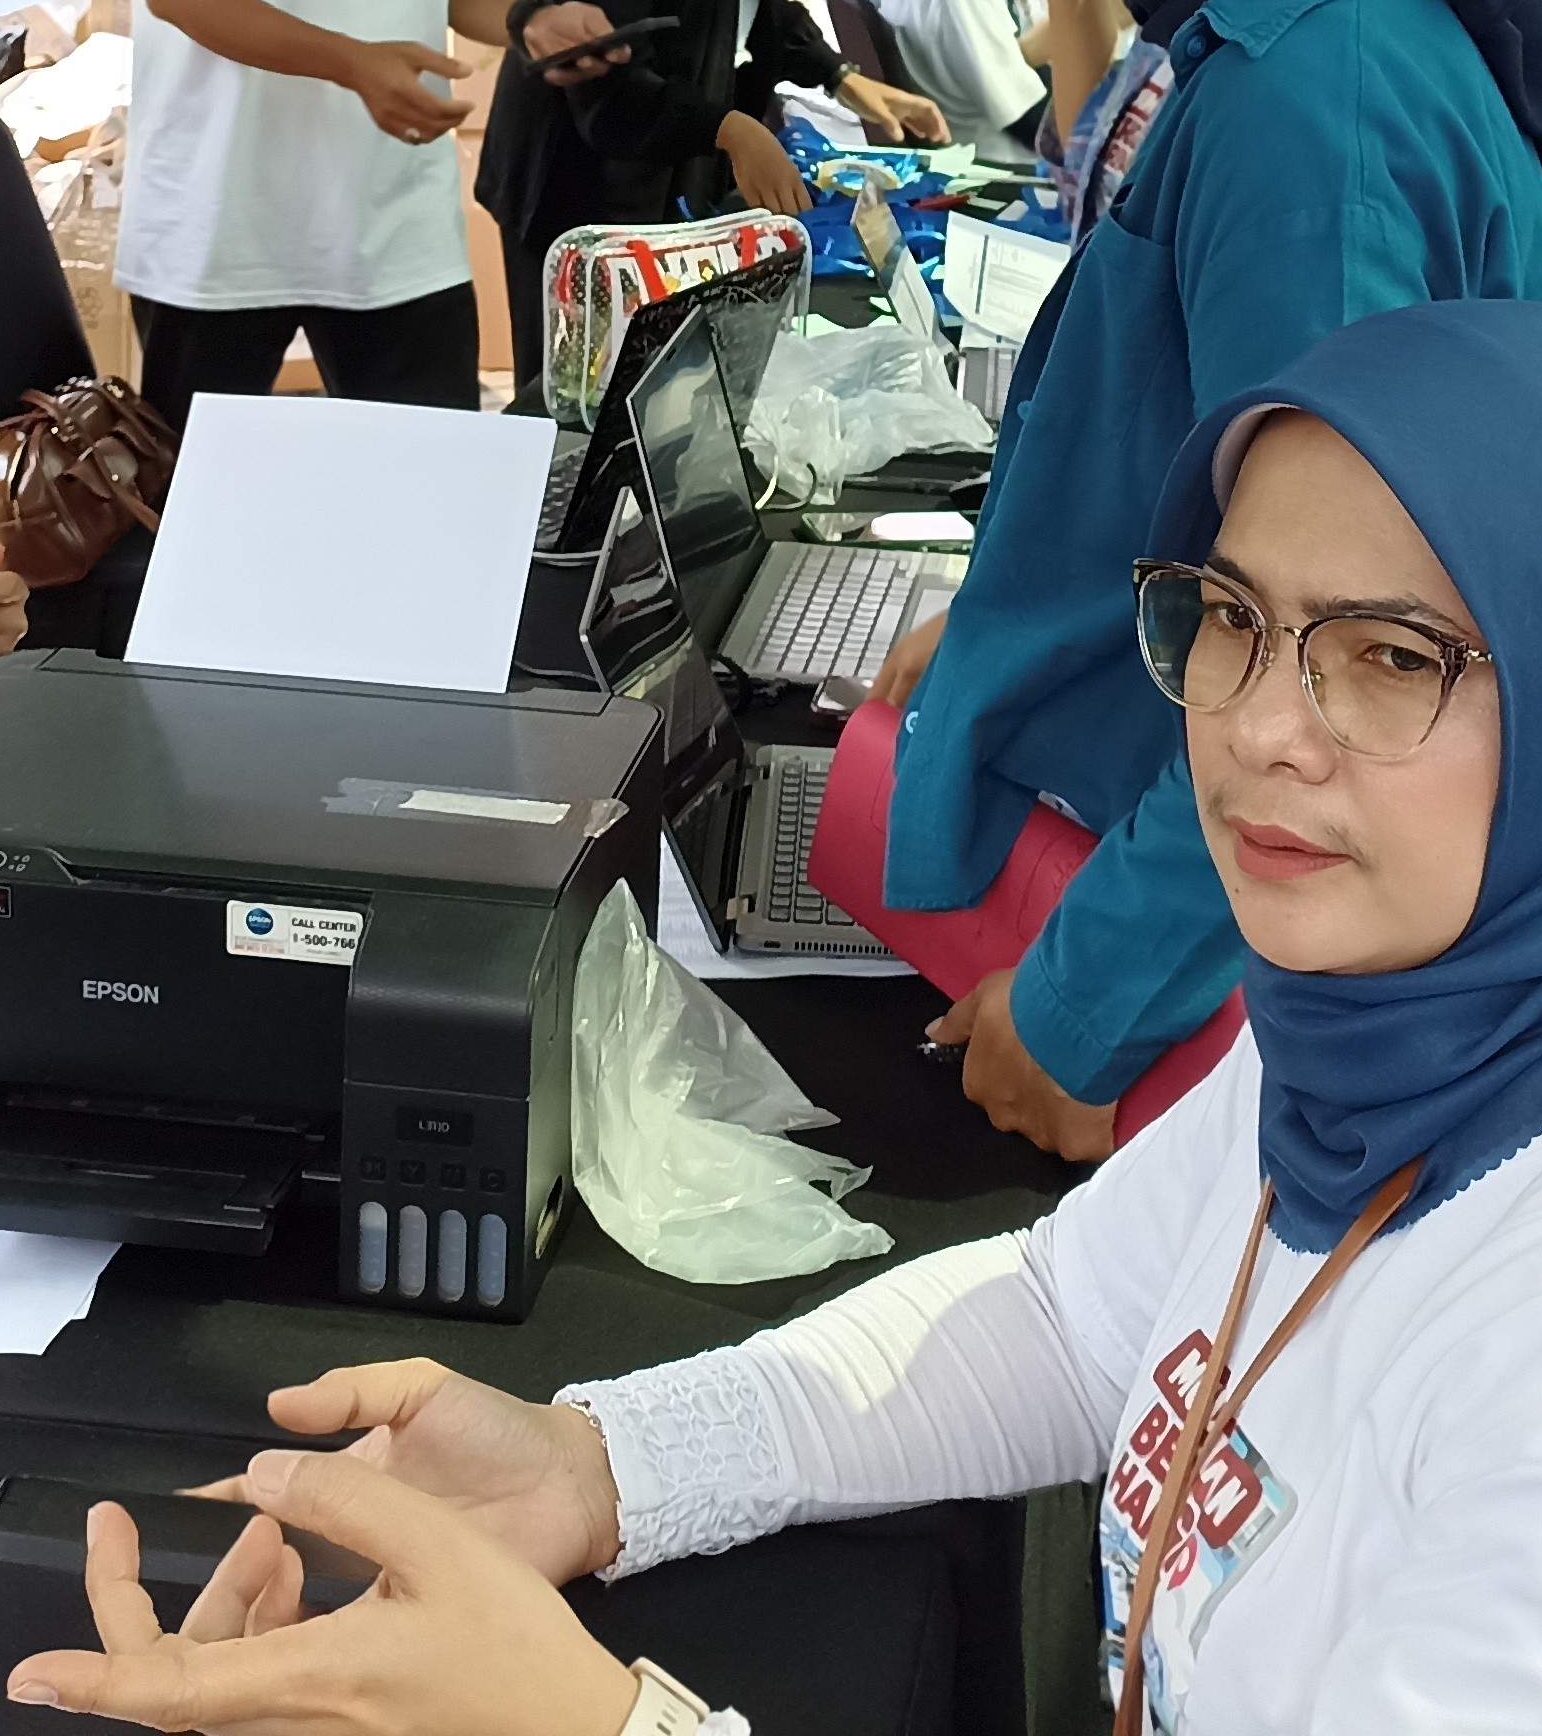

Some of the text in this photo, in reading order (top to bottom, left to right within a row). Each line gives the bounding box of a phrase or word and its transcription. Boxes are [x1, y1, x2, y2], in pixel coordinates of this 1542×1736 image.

[291, 917, 357, 932] CALL CENTER
[82, 979, 159, 1004] EPSON
